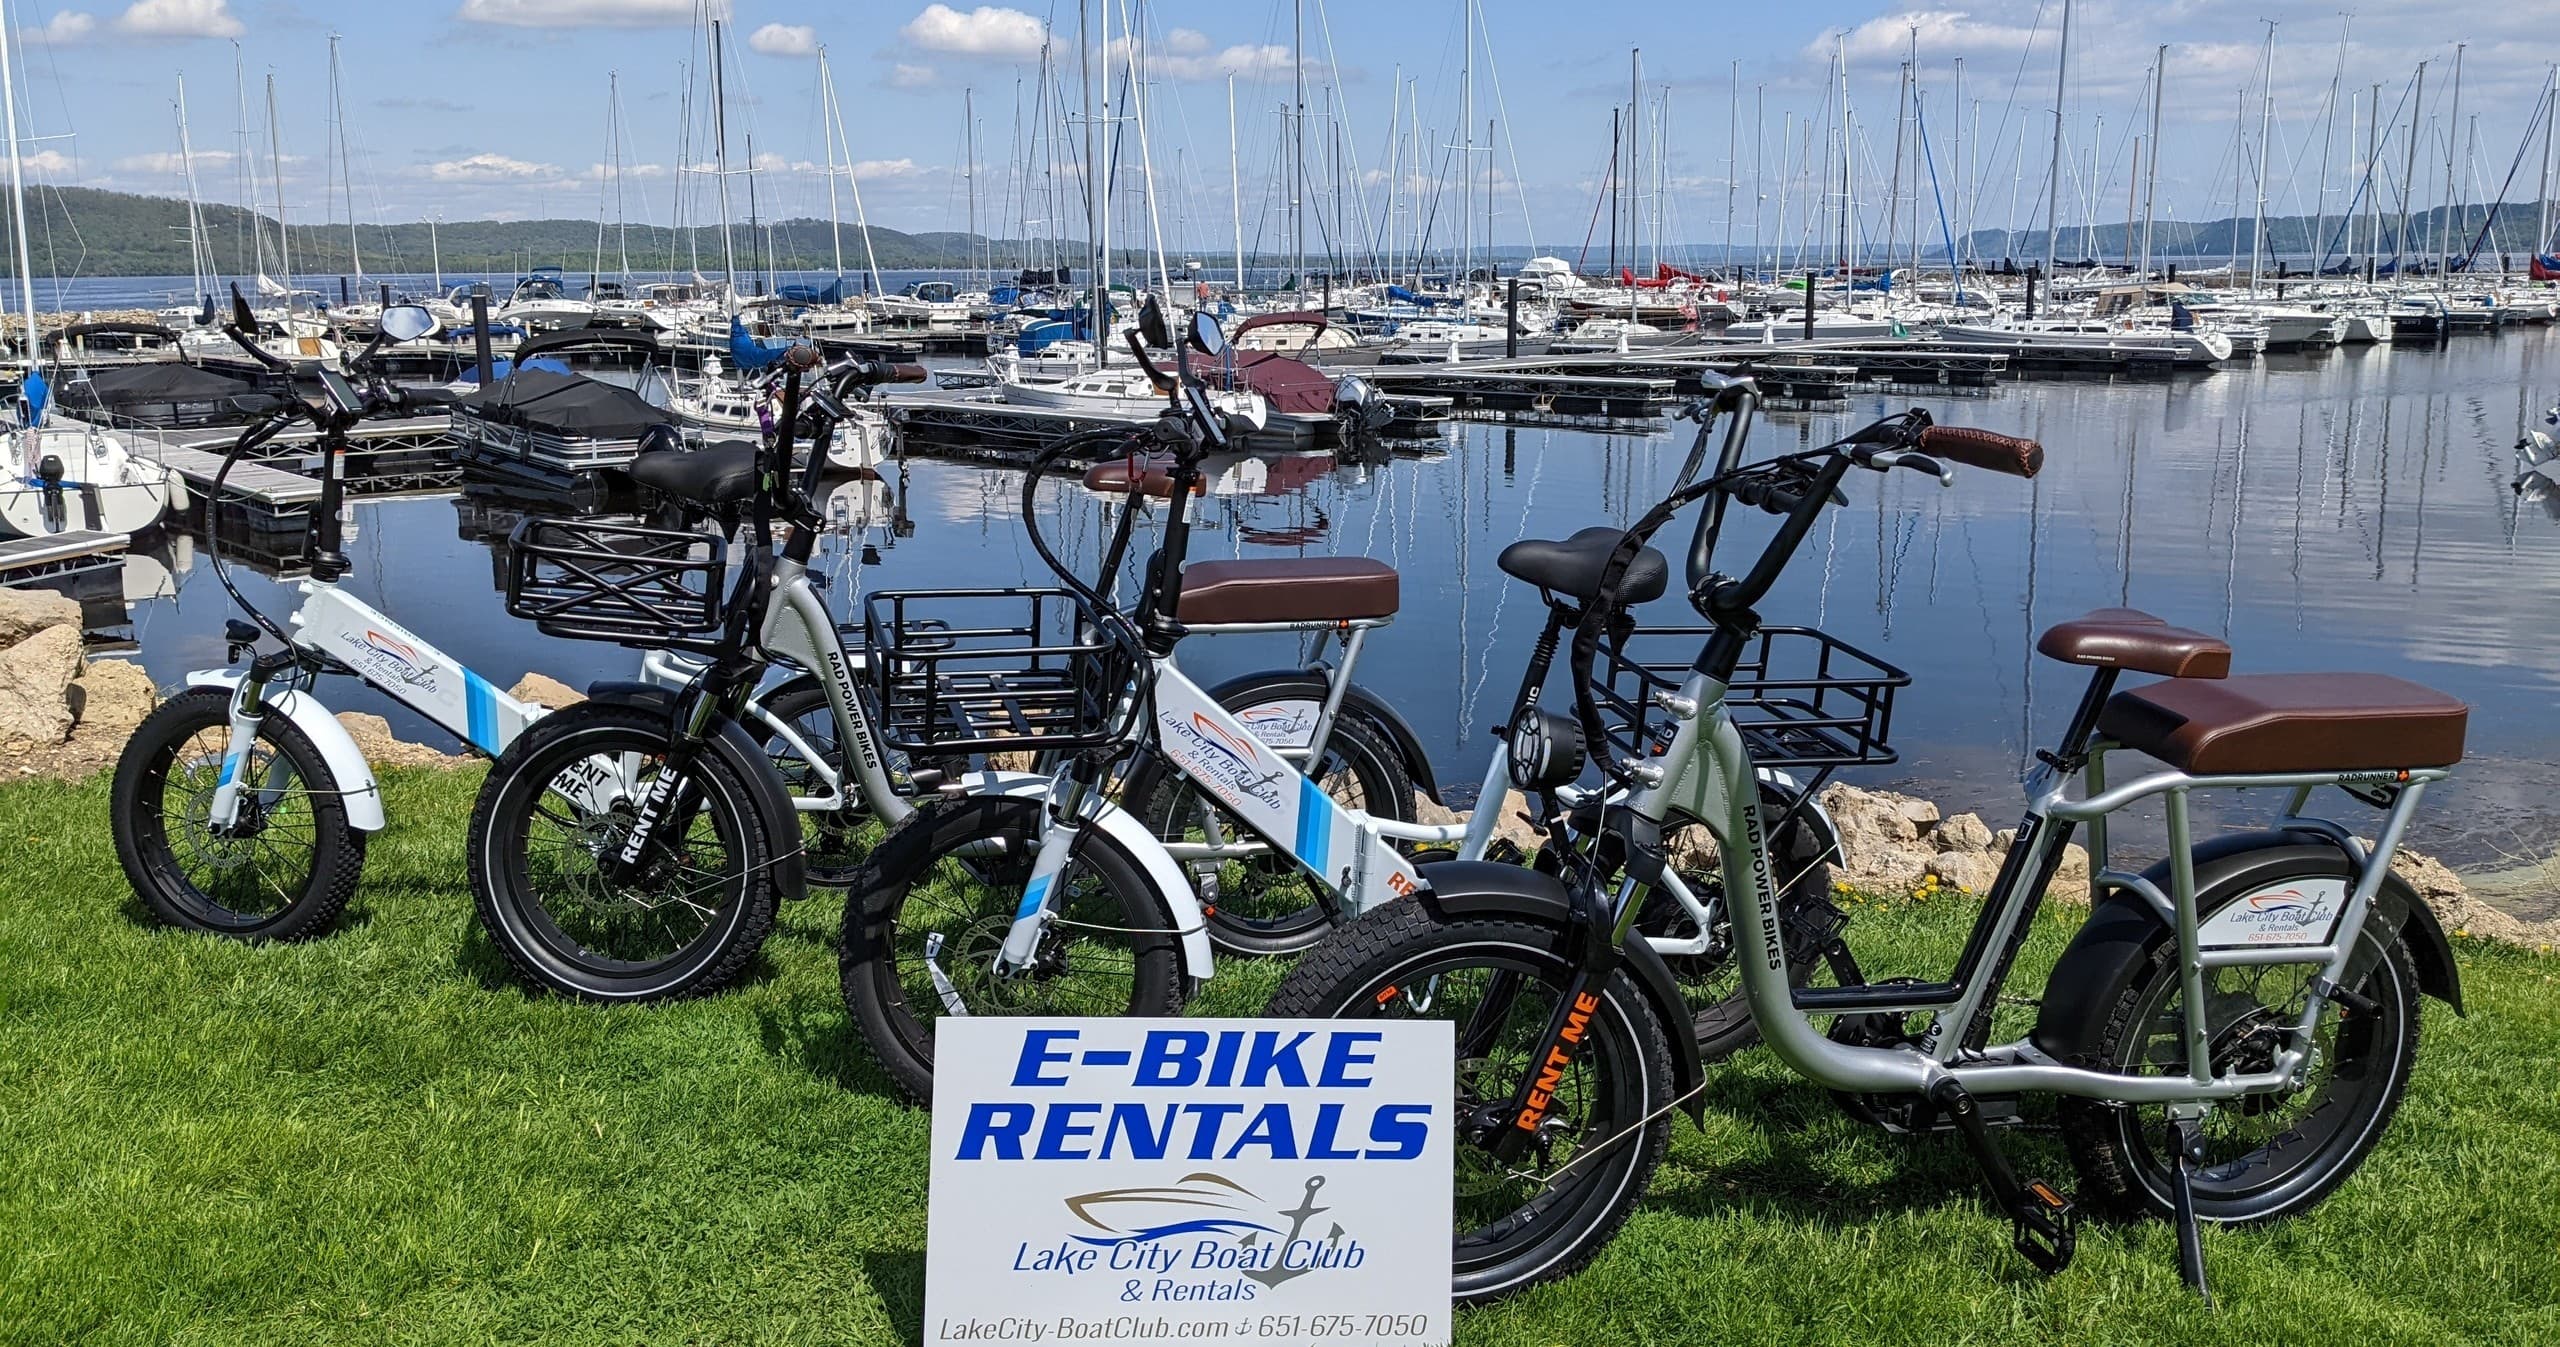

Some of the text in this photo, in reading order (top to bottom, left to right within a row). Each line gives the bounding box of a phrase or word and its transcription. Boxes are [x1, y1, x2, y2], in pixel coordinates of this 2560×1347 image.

[341, 632, 367, 650] Lake
[366, 648, 389, 664] City
[372, 662, 401, 682] Rentals
[827, 651, 877, 769] RAD POWER BIKES
[1250, 722, 1268, 731] City
[1159, 710, 1281, 810] Lake City Boat Club
[1188, 751, 1236, 791] & Rentals
[554, 773, 587, 799] ME
[1171, 749, 1243, 807] 651-675-7050
[2337, 772, 2396, 782] RADRUNNER
[620, 765, 678, 864] RENT ME
[1743, 805, 1781, 971] RAD POWER BIKES
[2230, 911, 2333, 924] Lake City Boat Club
[2267, 923, 2299, 932] Rentals
[2248, 932, 2307, 941] 651-675-7050
[1010, 1029, 1382, 1088] E-BIKE
[1516, 991, 1599, 1131] RENT ME
[955, 1103, 1432, 1160] RENTALS
[1013, 1240, 1365, 1275] Lake City Boat Club
[1120, 1278, 1256, 1301] & Rentals
[940, 1315, 1428, 1342] LakeCity-BoatClub.com 651-675-7050
